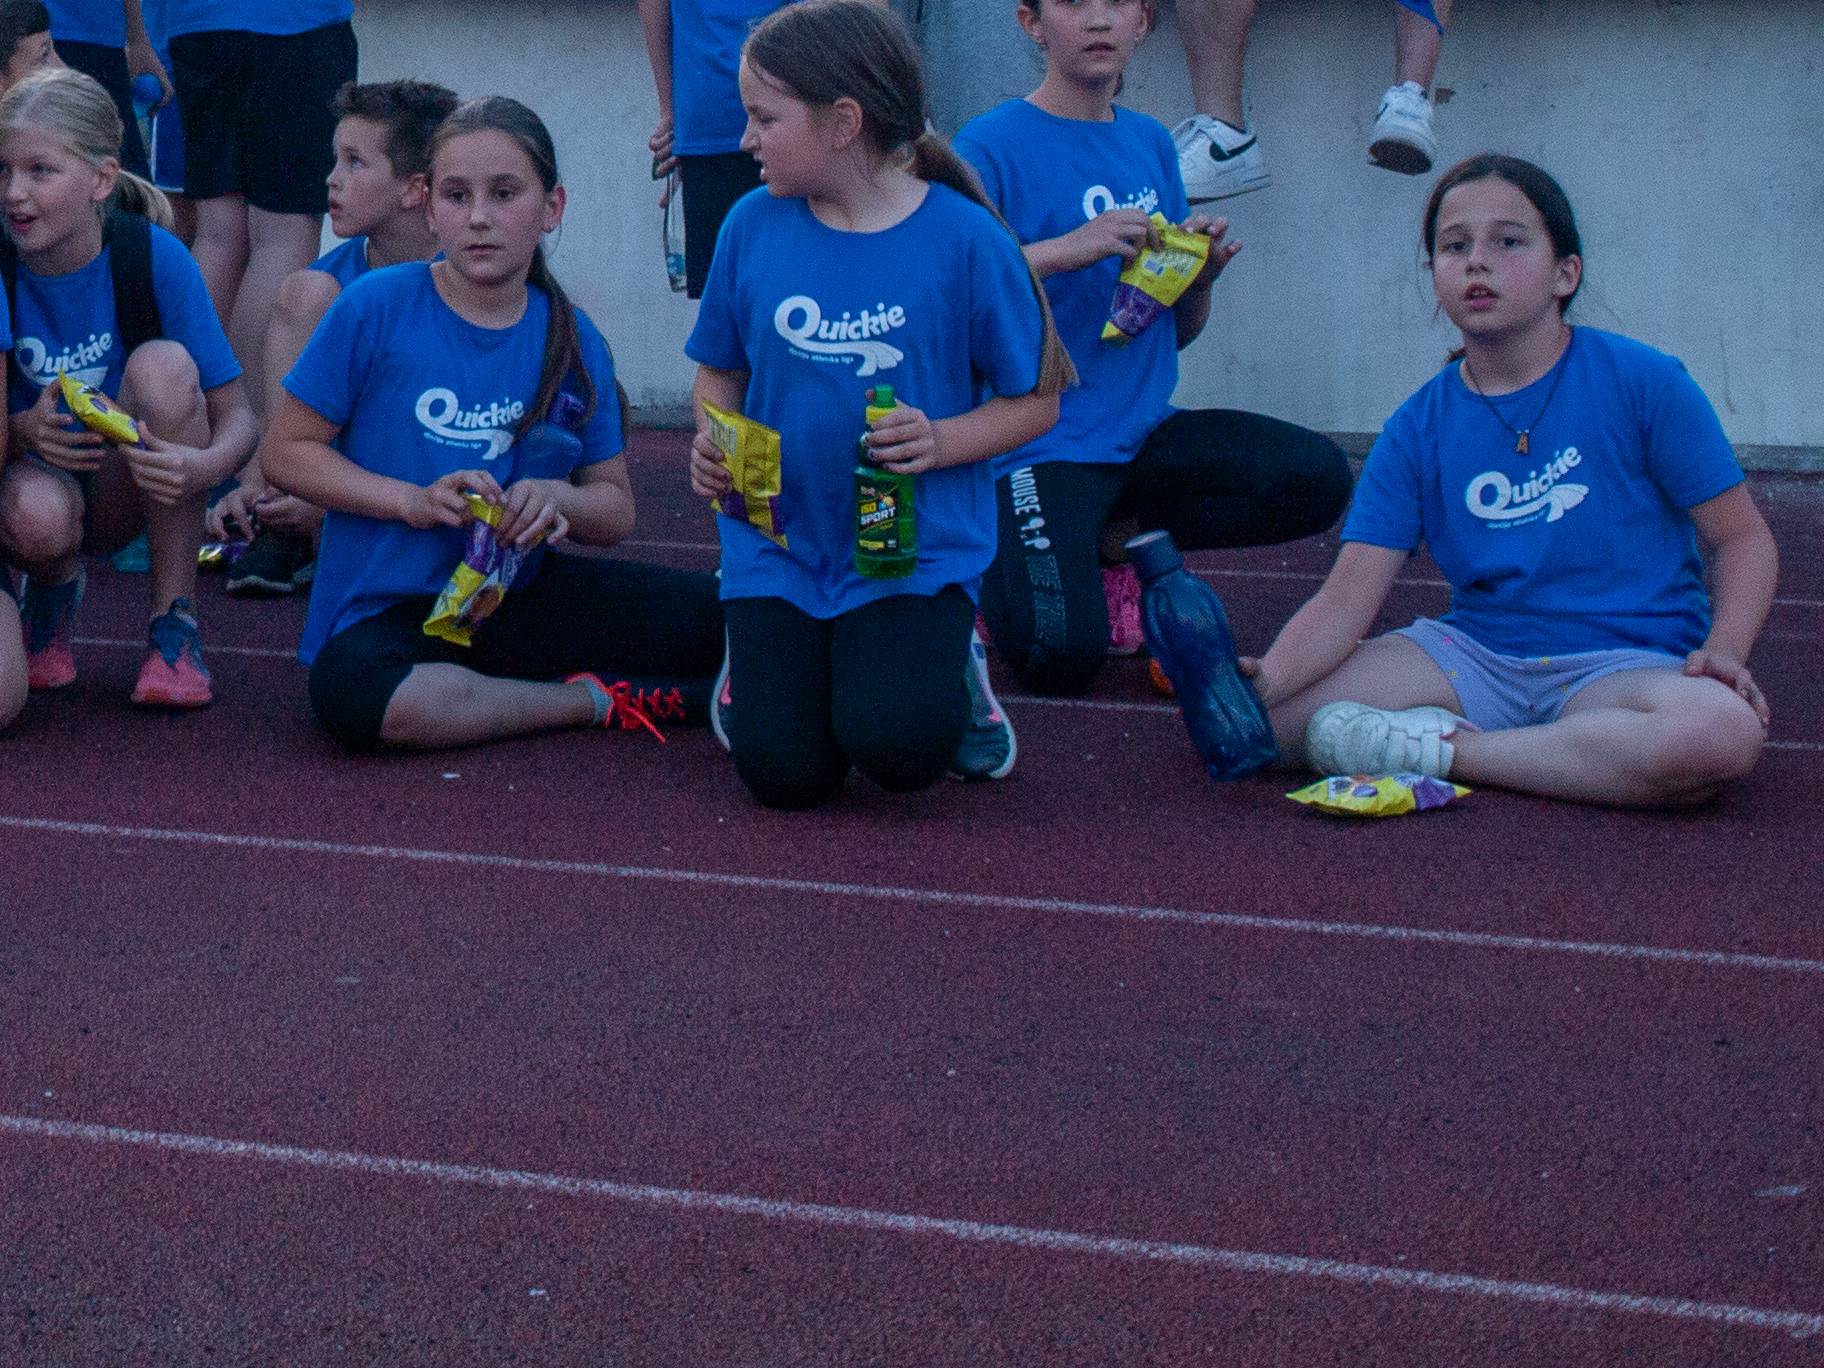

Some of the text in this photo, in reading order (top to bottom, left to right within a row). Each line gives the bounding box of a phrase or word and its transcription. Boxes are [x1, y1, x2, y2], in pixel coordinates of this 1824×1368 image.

[774, 295, 907, 354] Quickie
[15, 332, 113, 386] Quickie
[415, 387, 524, 441] Quickie
[1010, 466, 1042, 516] MOUSE
[1464, 445, 1582, 520] Quickie
[860, 506, 897, 526] SPORT
